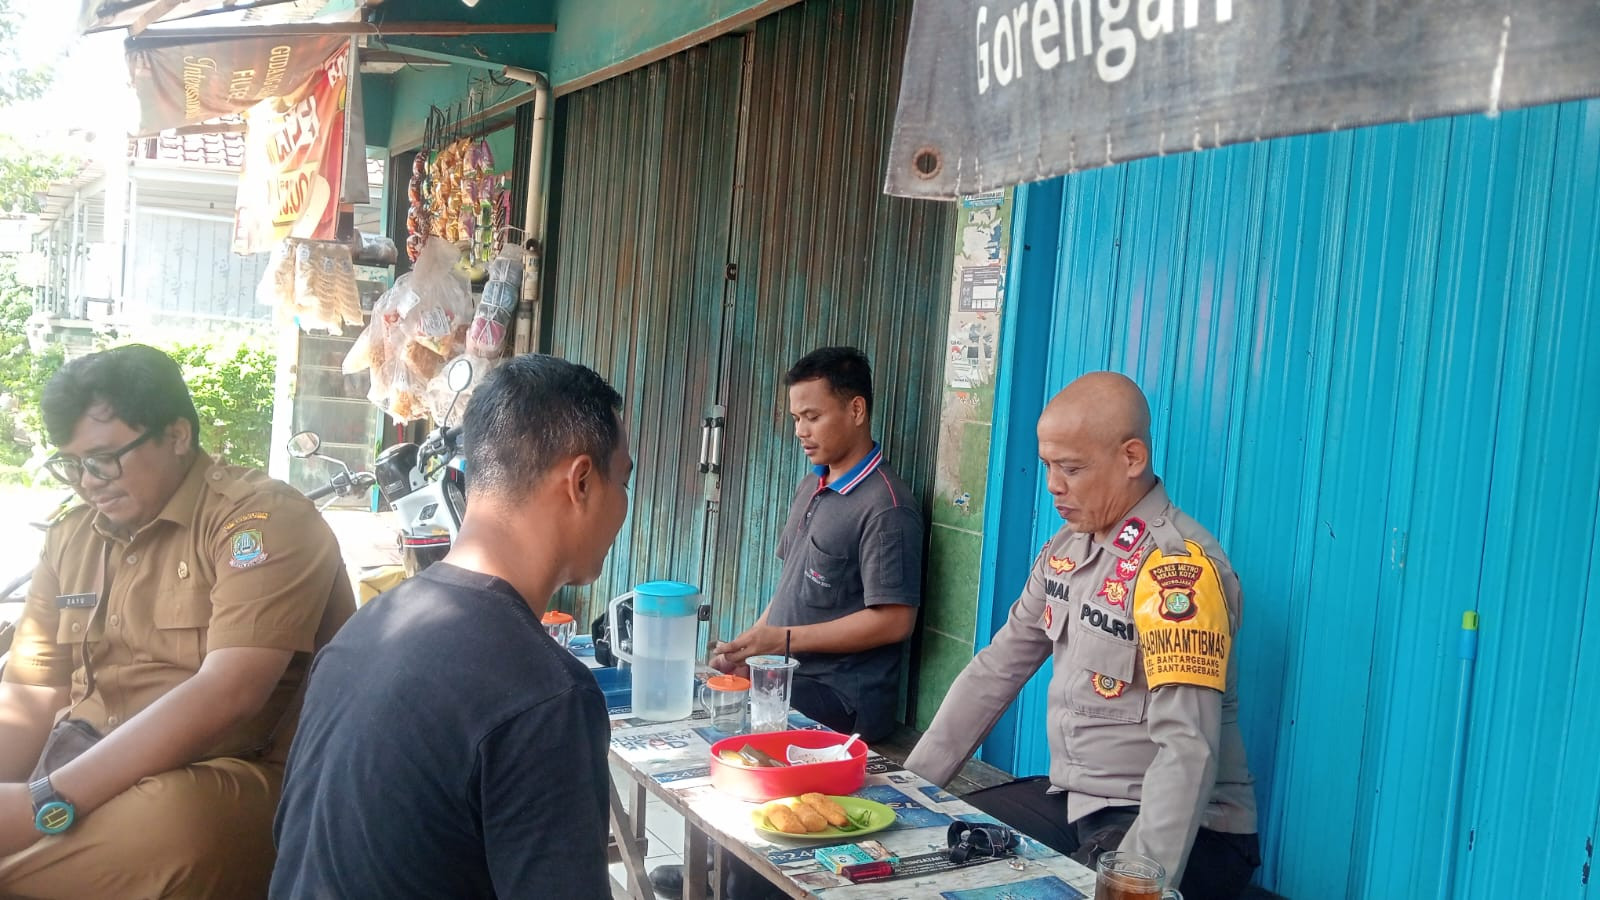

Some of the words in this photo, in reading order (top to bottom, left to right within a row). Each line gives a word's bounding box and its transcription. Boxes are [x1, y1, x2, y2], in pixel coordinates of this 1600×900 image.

[1080, 603, 1134, 641] POLRI
[1157, 655, 1220, 669] BANTARGEBANG
[1157, 664, 1220, 678] BANTARGEBANG
